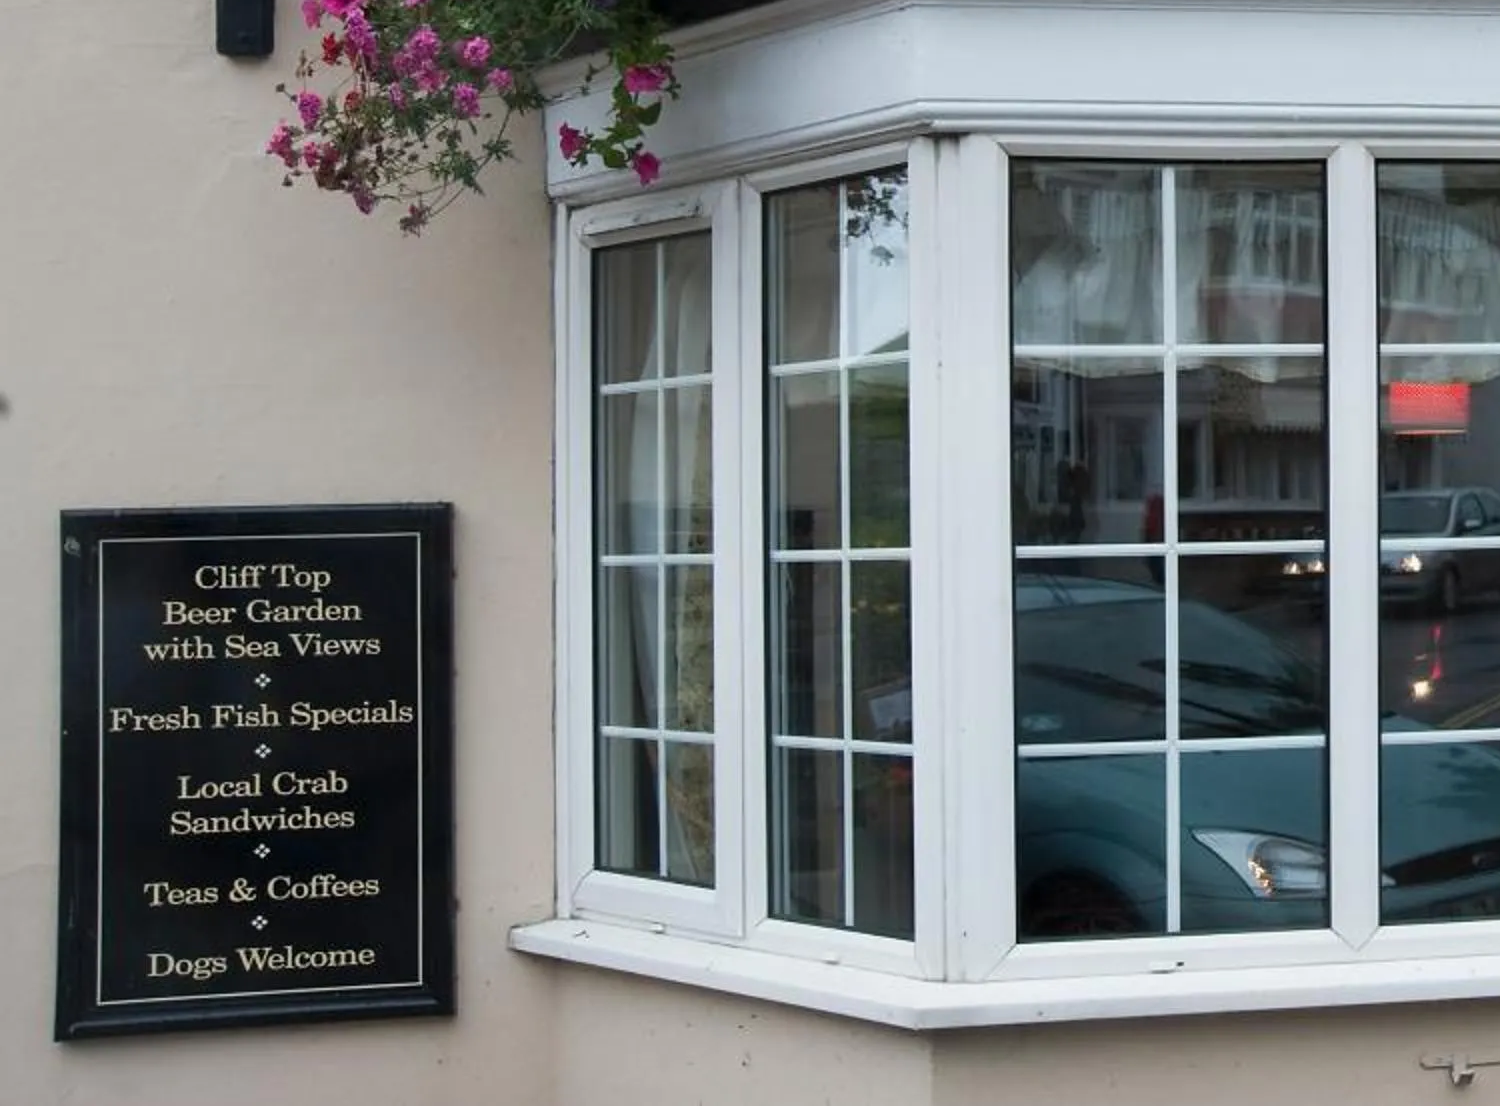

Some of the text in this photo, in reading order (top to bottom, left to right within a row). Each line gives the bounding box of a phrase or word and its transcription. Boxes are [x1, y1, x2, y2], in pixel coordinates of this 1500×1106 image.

[195, 565, 330, 592] Cliff Top
[163, 598, 362, 624] Beer Garden
[144, 633, 380, 660] with Sea Views
[110, 700, 413, 732] Fresh Fish Specials
[178, 770, 347, 799] Local Crab
[171, 806, 354, 834] Sandwiches
[144, 874, 379, 906] Teas & Coffees
[148, 946, 374, 980] Dogs Welcome
